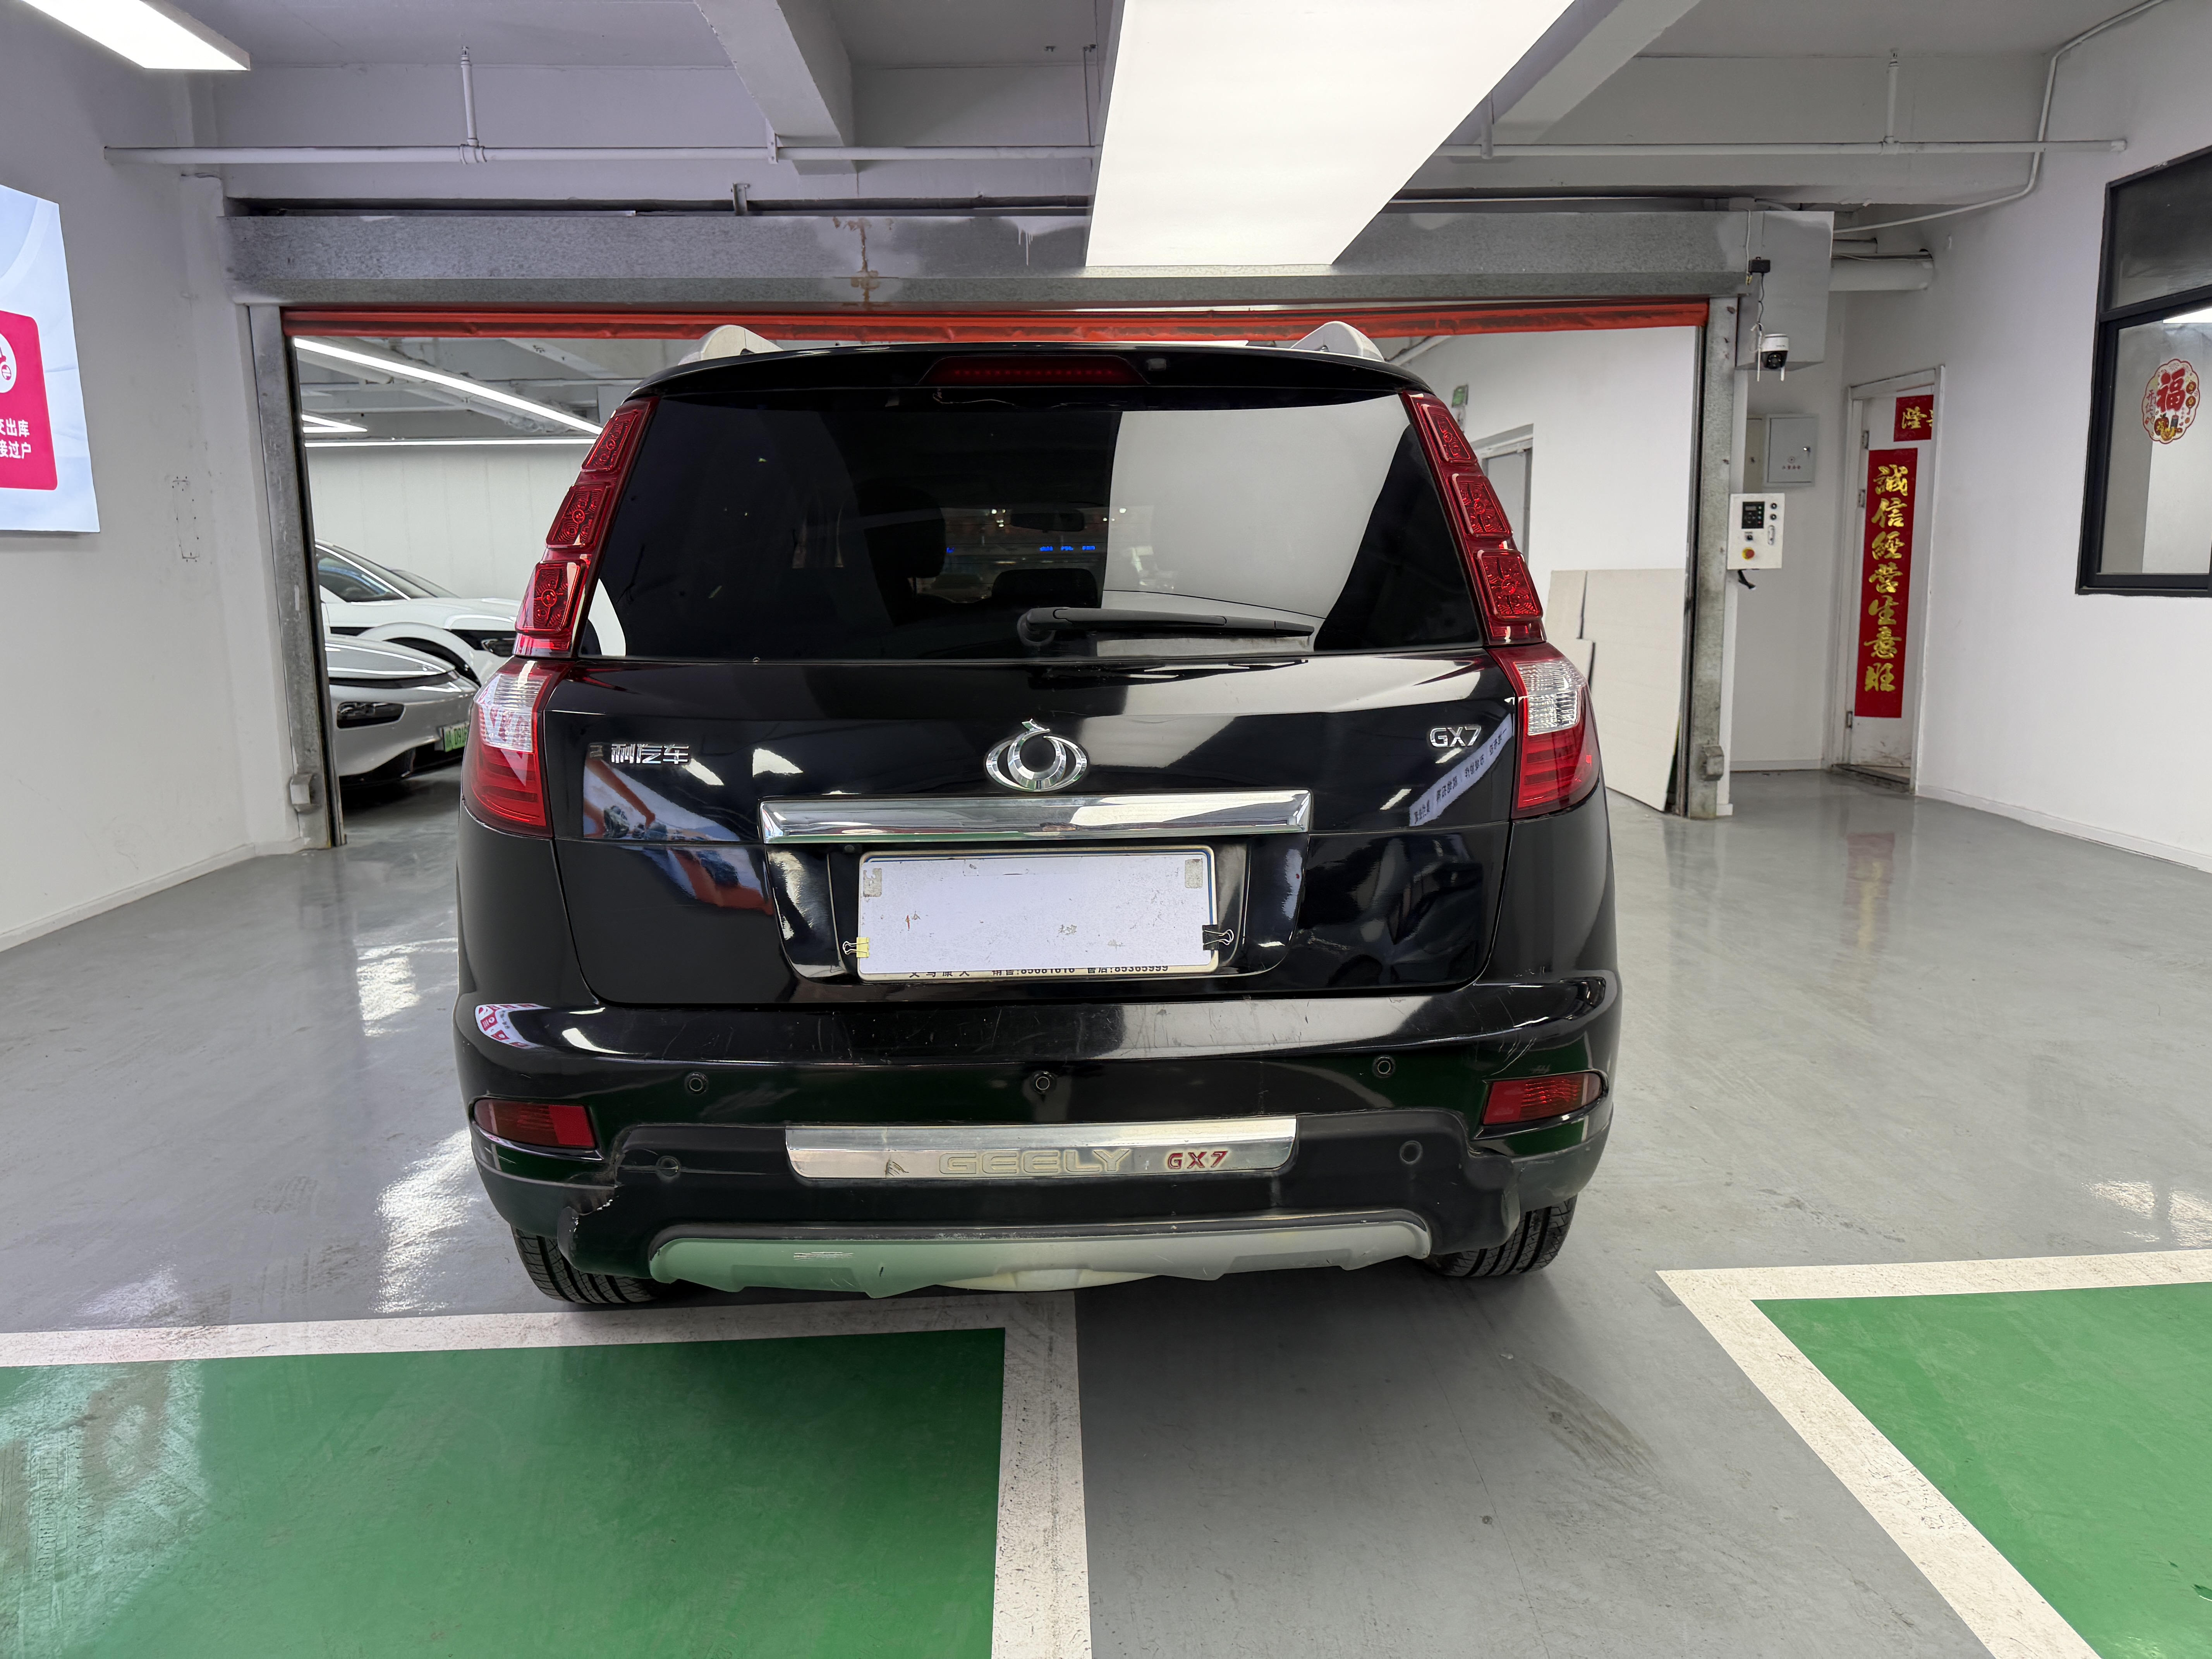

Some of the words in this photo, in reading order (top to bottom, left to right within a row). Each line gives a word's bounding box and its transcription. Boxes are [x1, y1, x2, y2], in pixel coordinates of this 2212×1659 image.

[2156, 368, 2186, 412] 福
[1430, 726, 1482, 748] GX7
[939, 1149, 1131, 1175] GEELY
[1167, 1150, 1229, 1169] GX7
